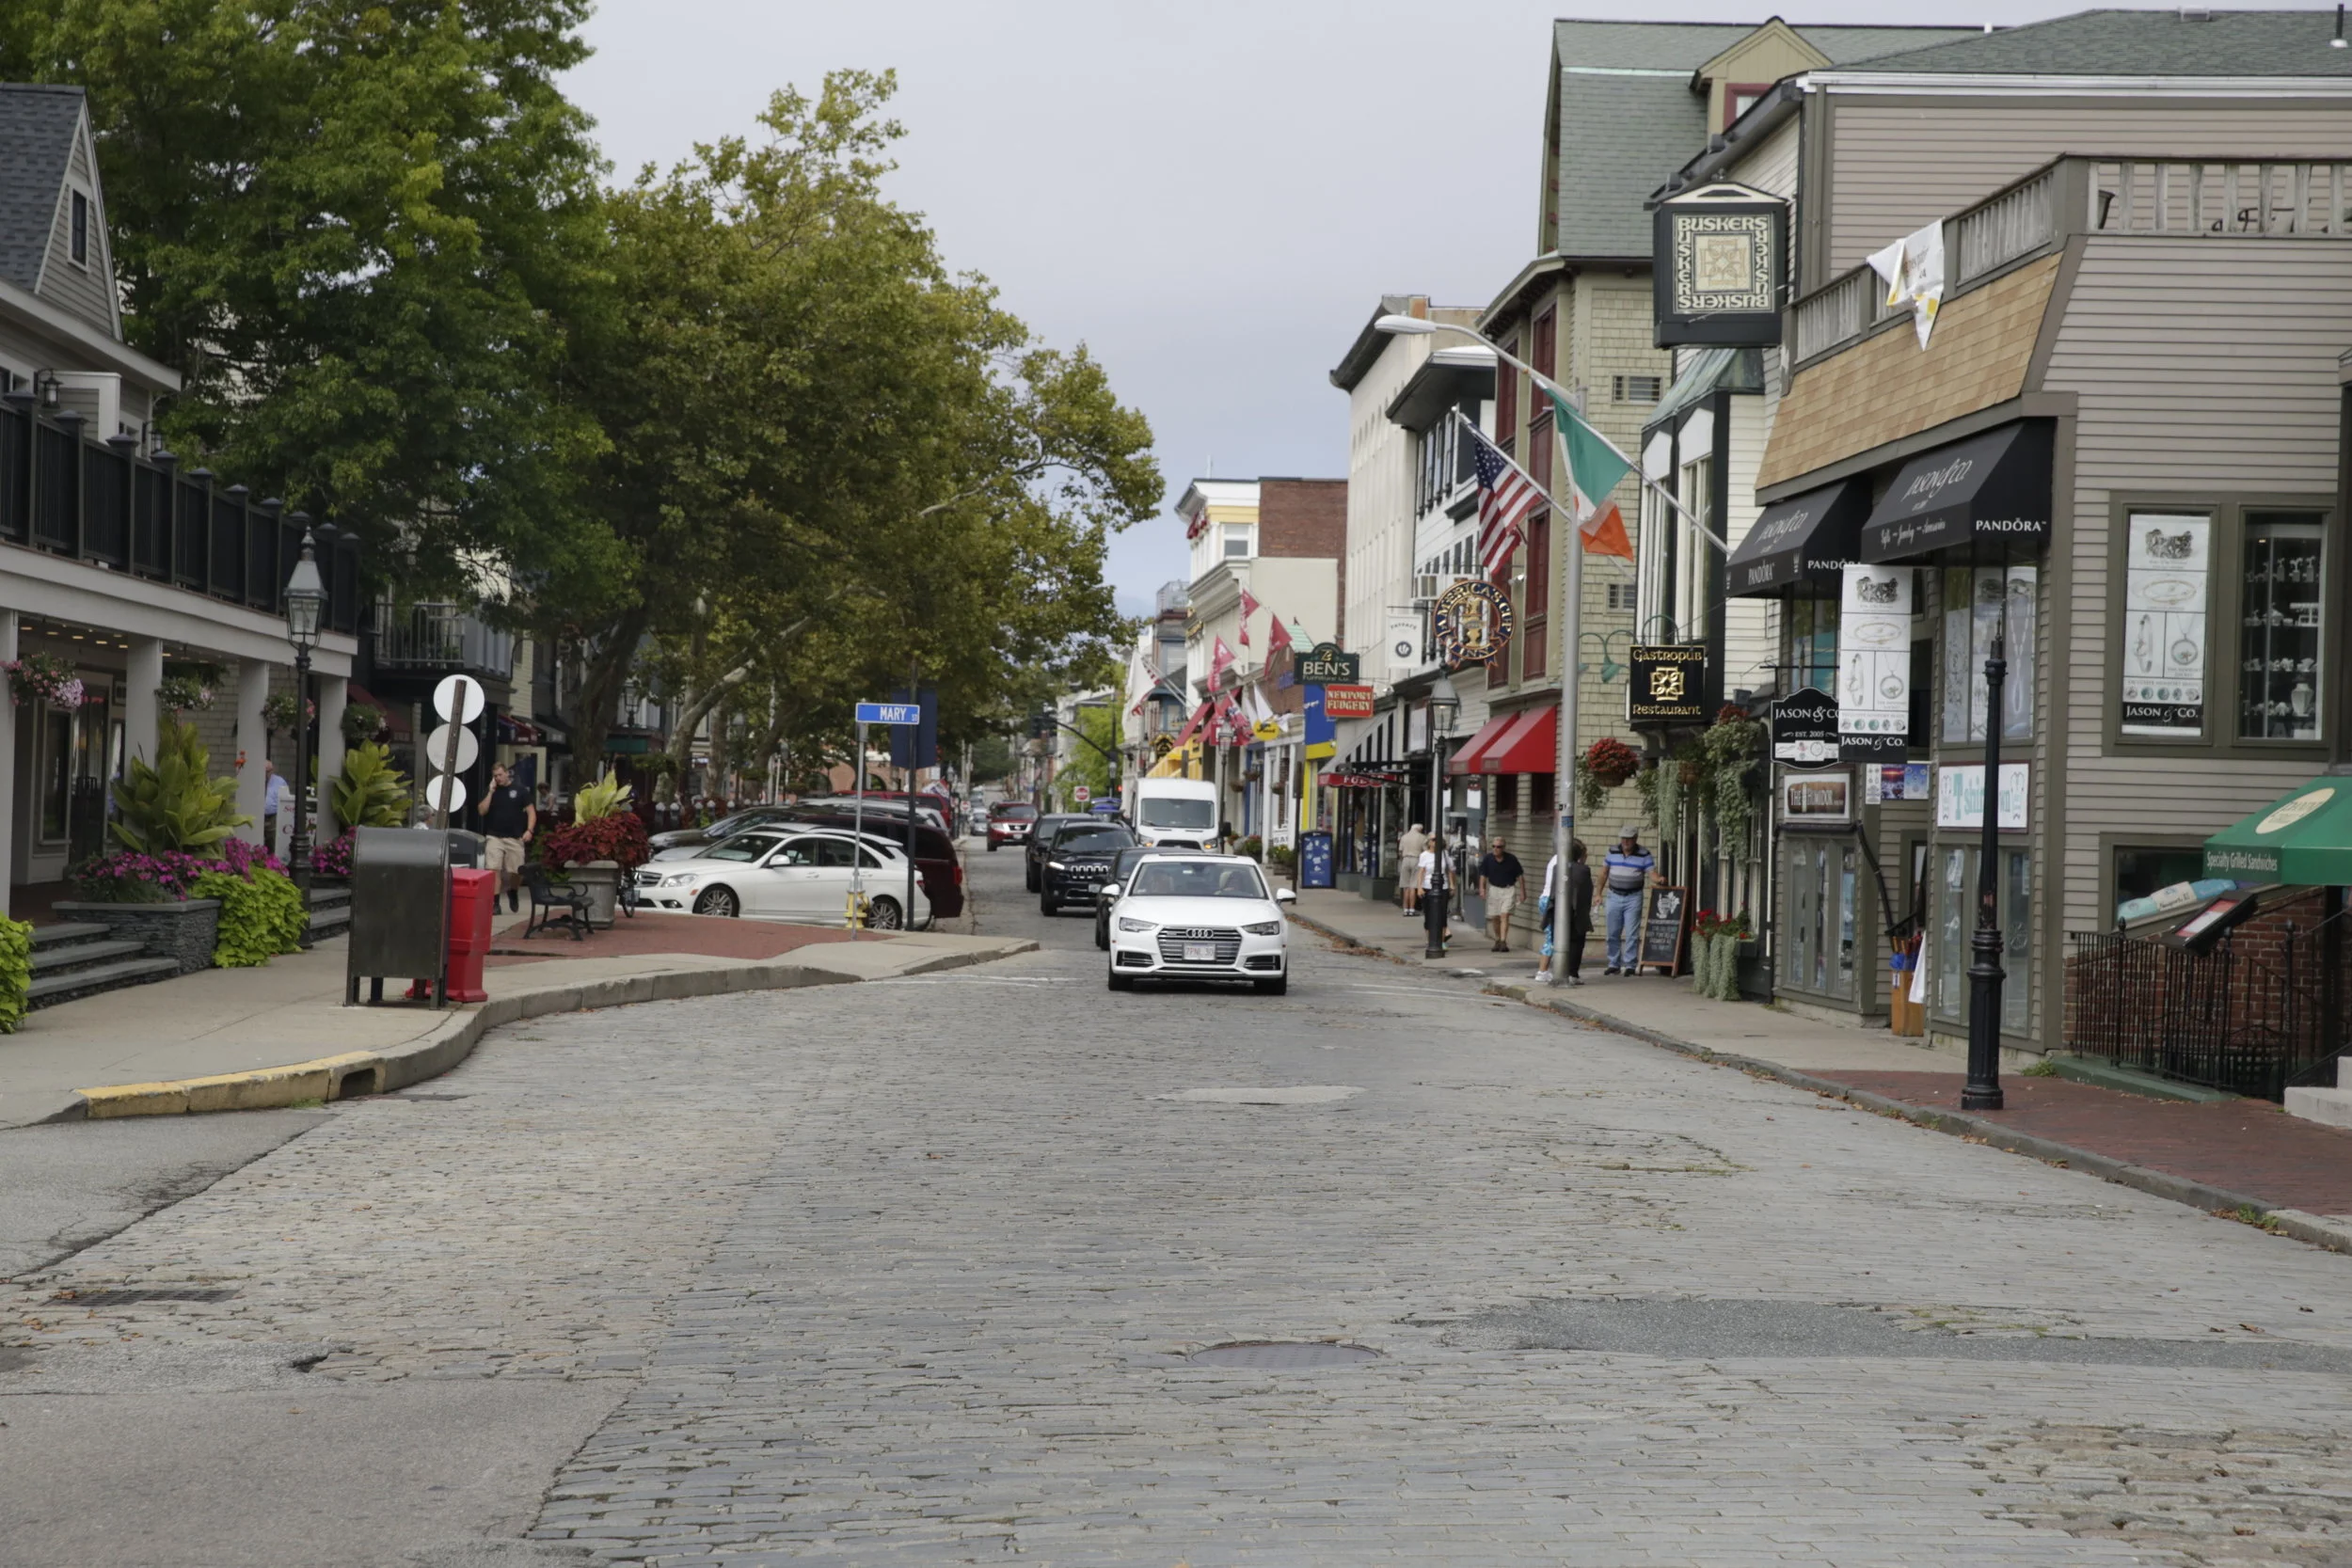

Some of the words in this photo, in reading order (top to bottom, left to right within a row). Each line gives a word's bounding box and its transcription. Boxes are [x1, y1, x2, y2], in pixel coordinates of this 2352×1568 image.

[1677, 216, 1768, 231] BUSKERS
[1302, 661, 1350, 676] BEN'S
[1327, 690, 1371, 701] NEWPORT
[1327, 700, 1371, 711] FUDGERY
[880, 706, 907, 721] MARY
[1775, 708, 1811, 720] JASON
[1812, 706, 1827, 722] &
[2207, 850, 2230, 873] Specialty
[2230, 852, 2248, 869] Grilled
[2249, 853, 2278, 871] Sandwiches
